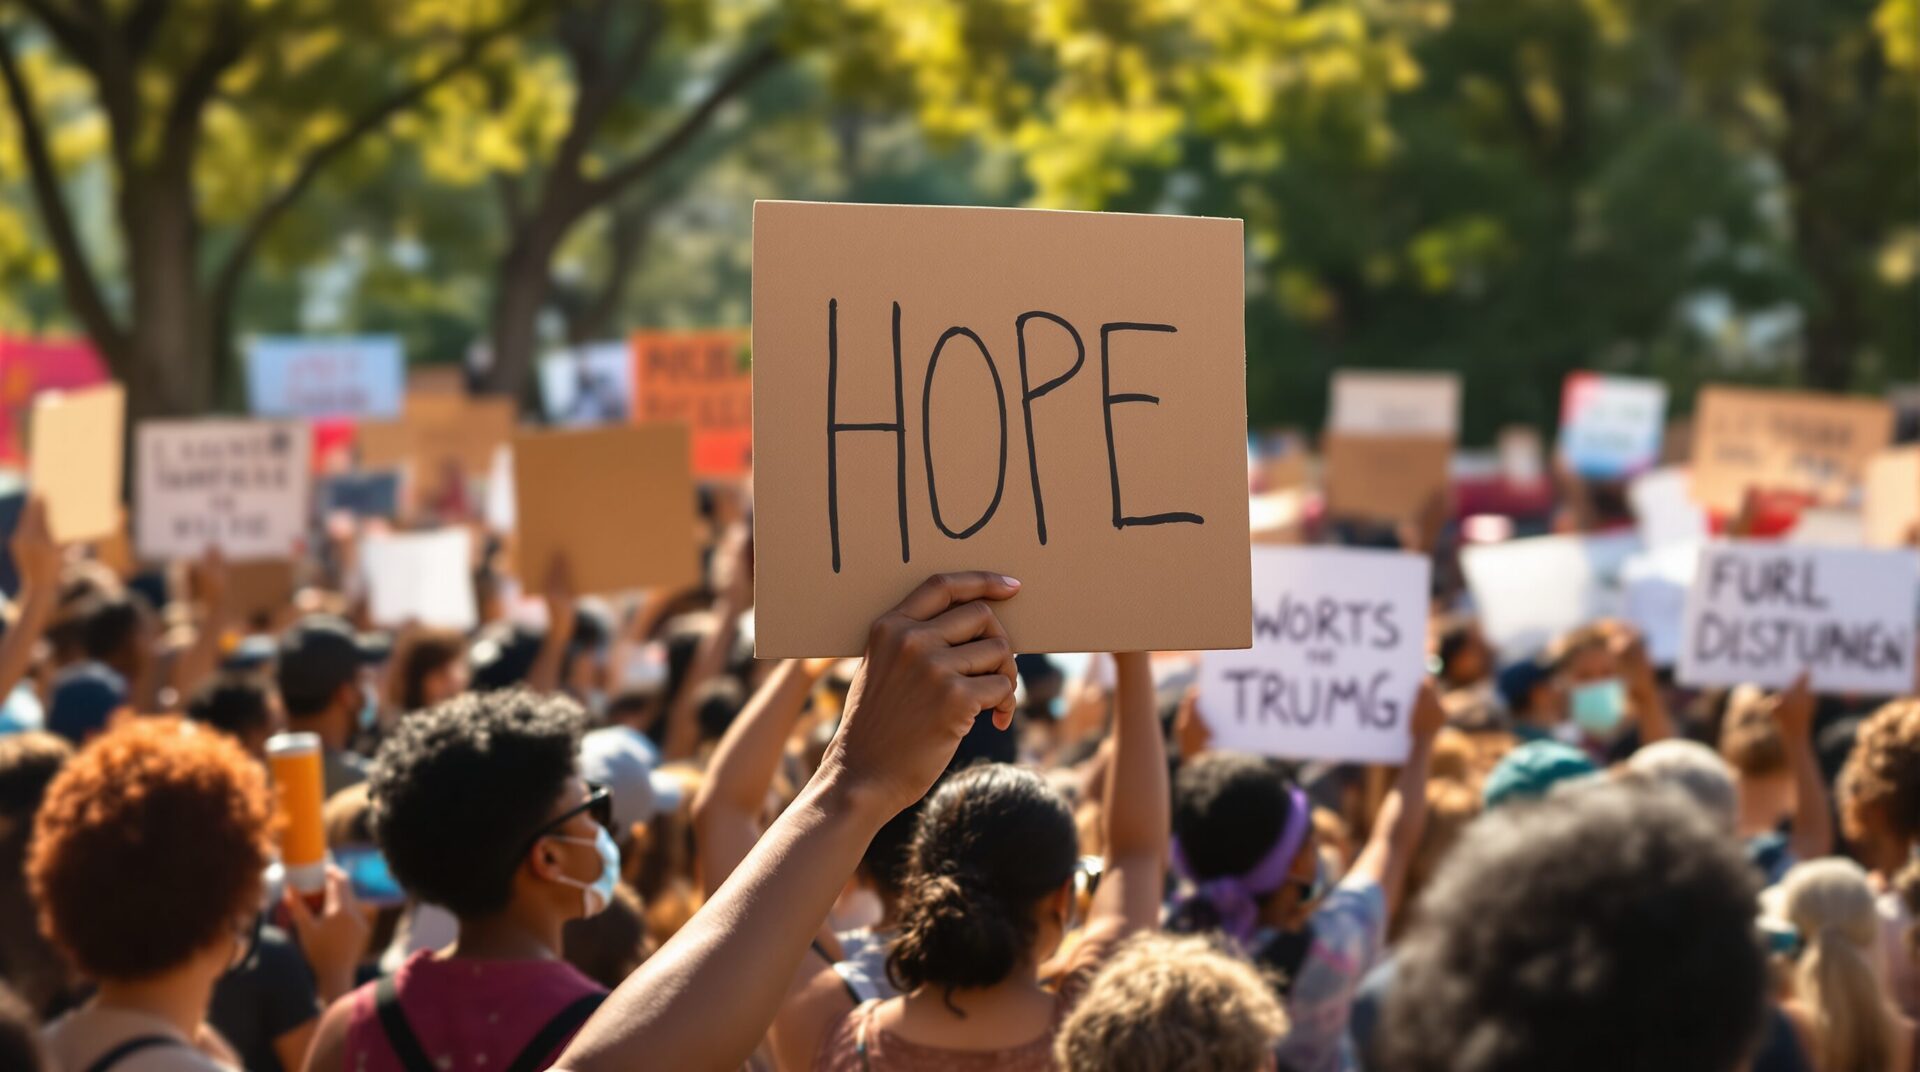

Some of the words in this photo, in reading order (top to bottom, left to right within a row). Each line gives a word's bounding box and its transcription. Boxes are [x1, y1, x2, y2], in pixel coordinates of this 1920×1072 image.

[827, 298, 1204, 573] HOPE
[1709, 556, 1829, 609] FURL
[1222, 669, 1398, 731] TRUMG
